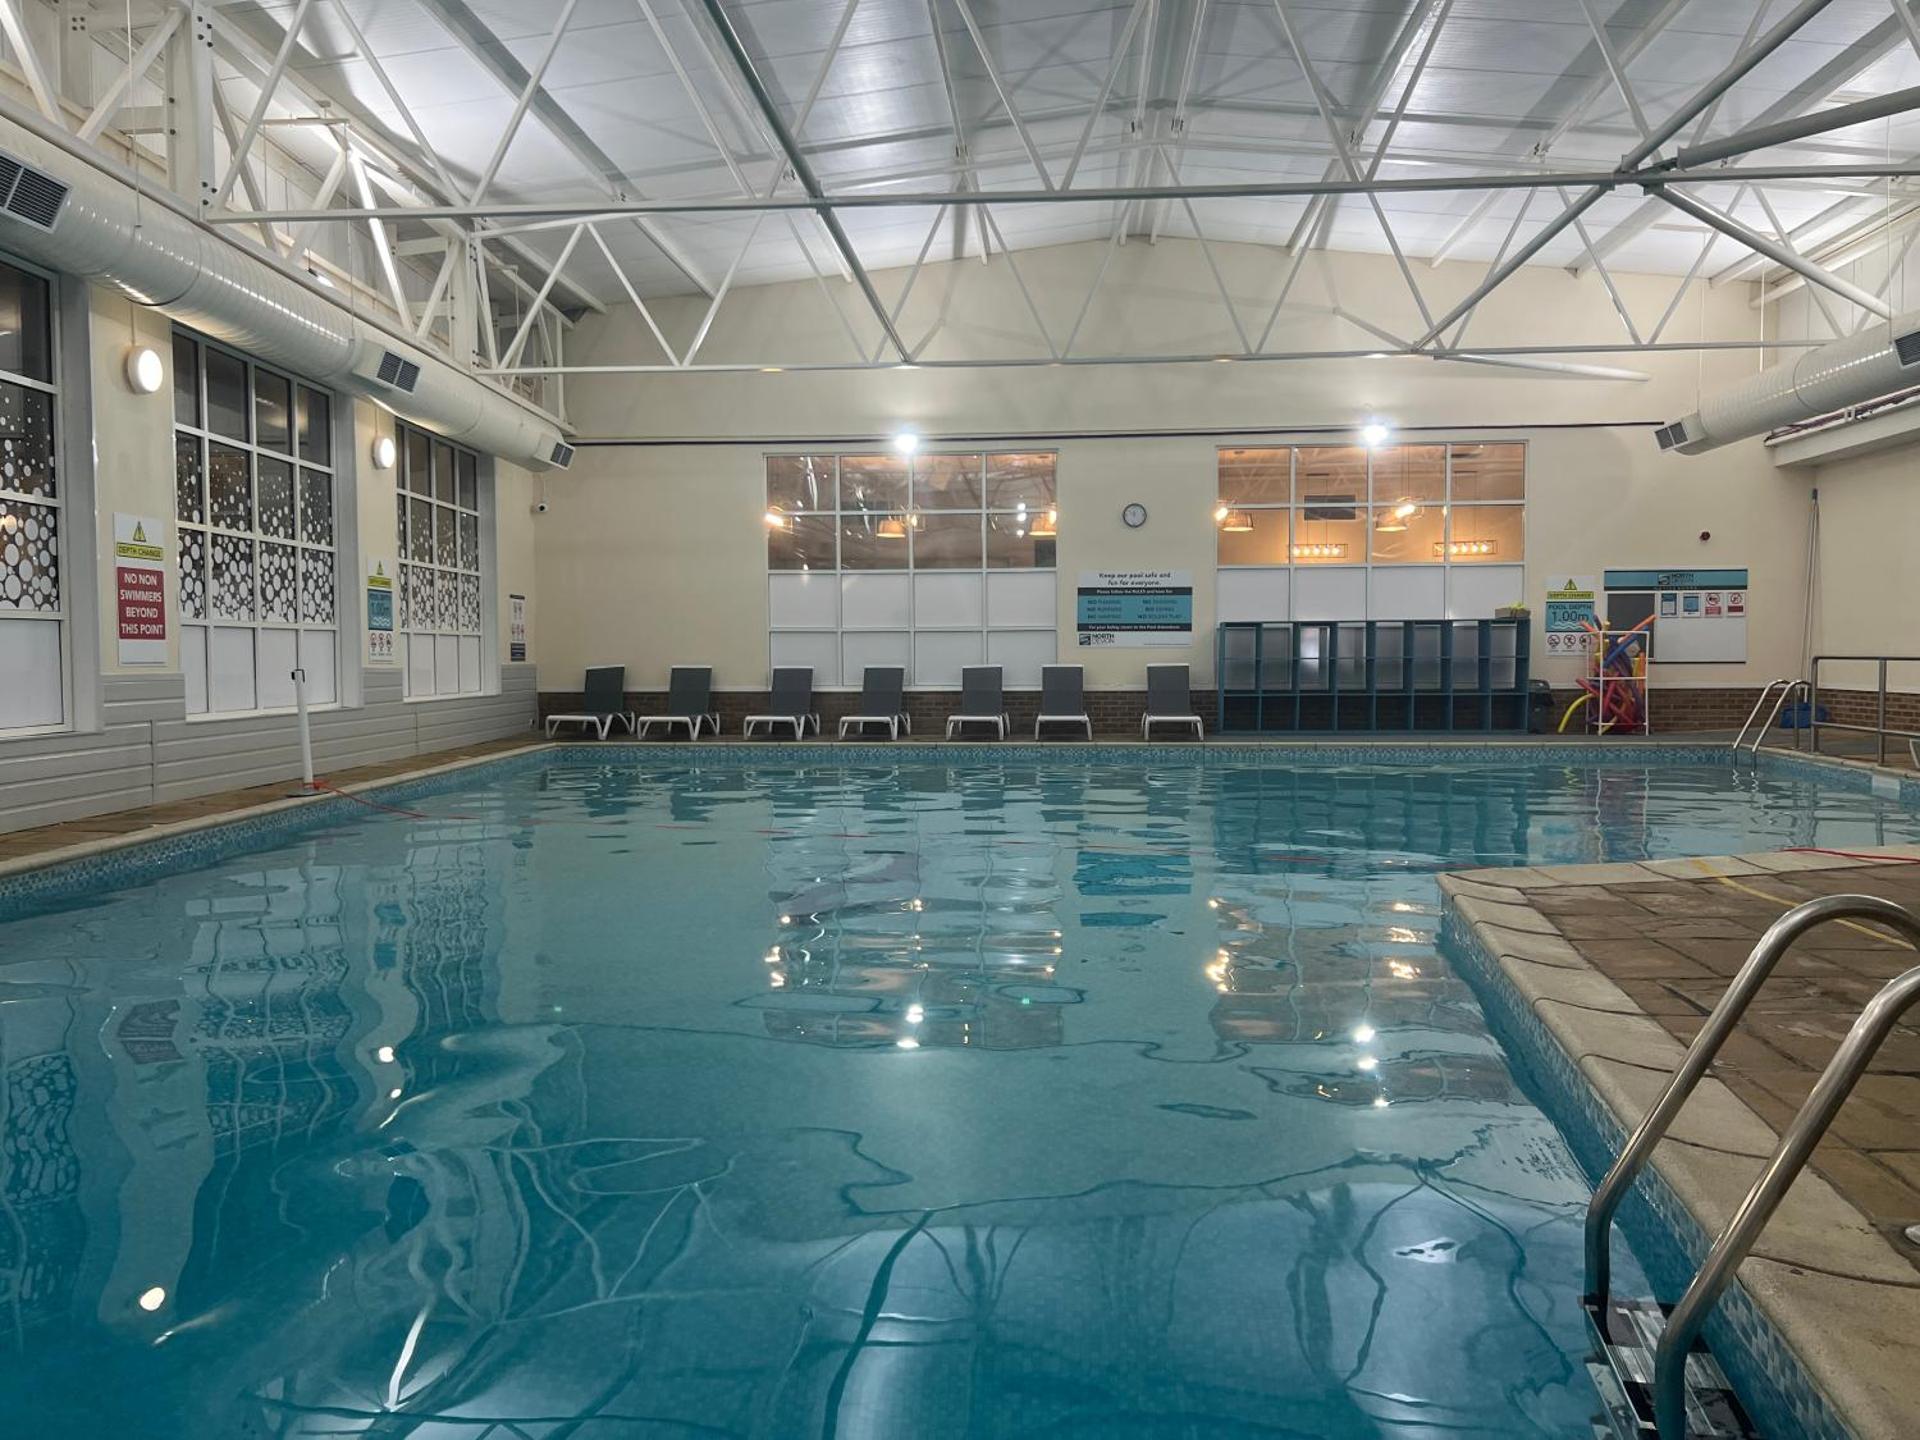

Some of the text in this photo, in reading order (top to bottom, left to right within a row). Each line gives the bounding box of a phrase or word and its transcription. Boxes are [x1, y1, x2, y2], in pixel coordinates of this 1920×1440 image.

[124, 573, 158, 586] NO NON
[120, 589, 162, 603] SWIMMERS
[126, 606, 158, 618] BEYOND
[1551, 610, 1589, 622] 1.00m
[121, 623, 164, 635] THIS POINT
